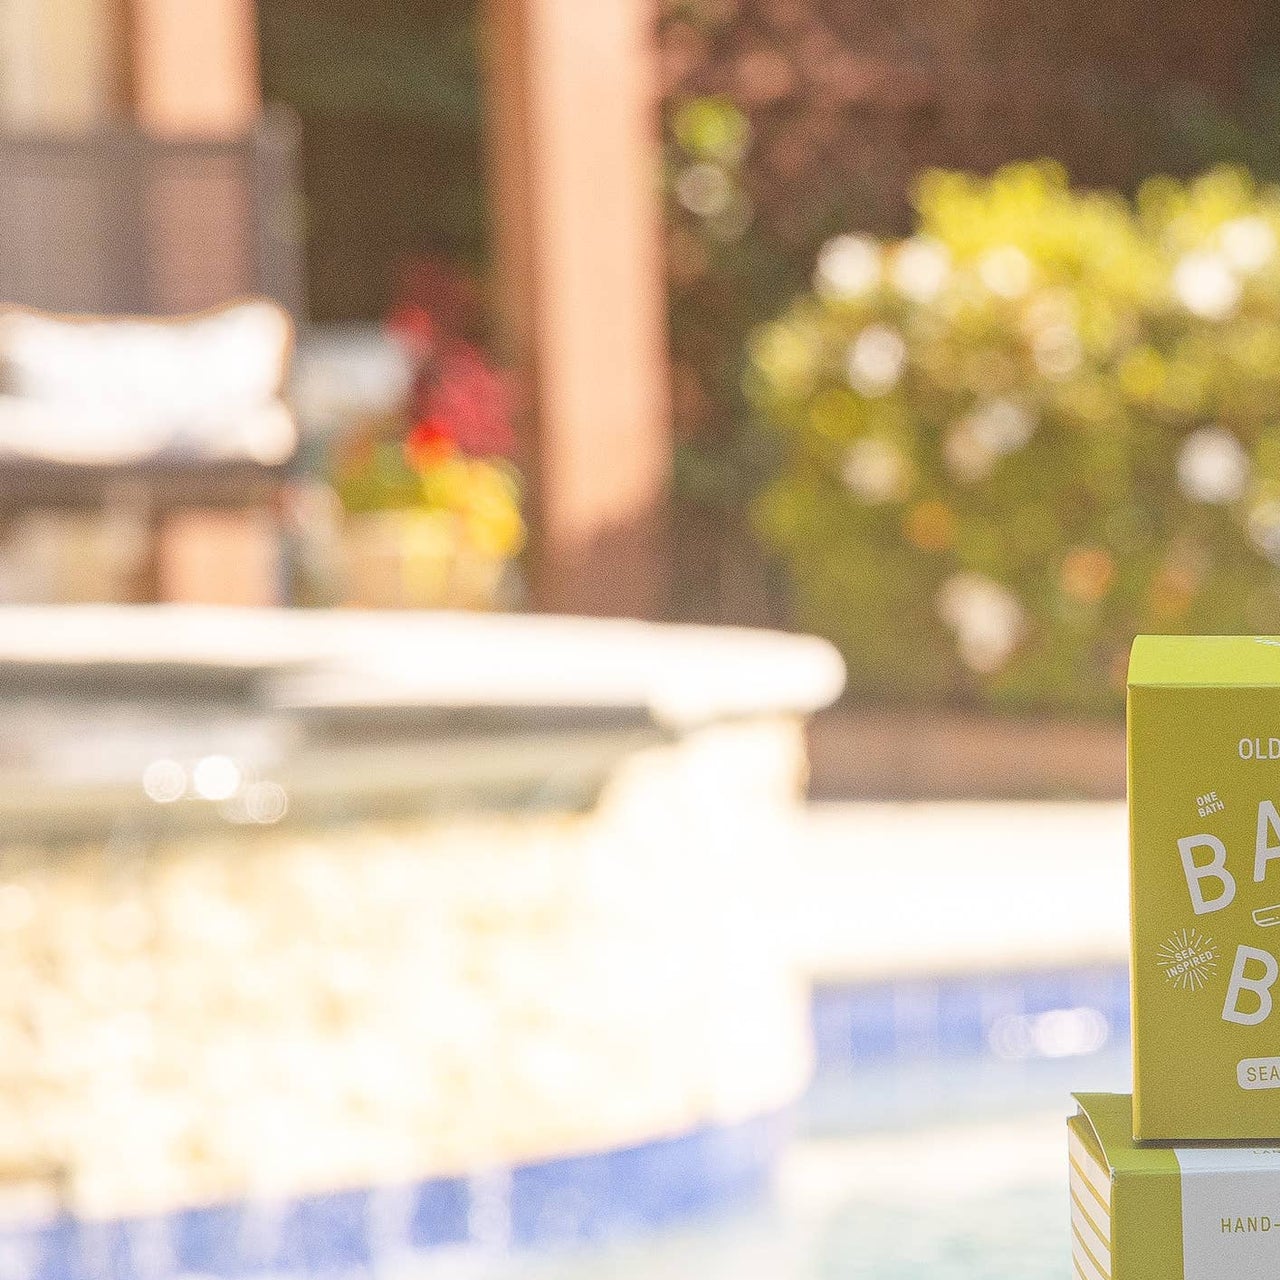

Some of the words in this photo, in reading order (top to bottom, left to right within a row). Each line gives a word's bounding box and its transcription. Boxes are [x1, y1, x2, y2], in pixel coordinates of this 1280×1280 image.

[1196, 791, 1218, 807] ONE
[1198, 801, 1225, 818] BATH
[1174, 947, 1196, 962] SEA
[1166, 951, 1213, 978] INSPIRED
